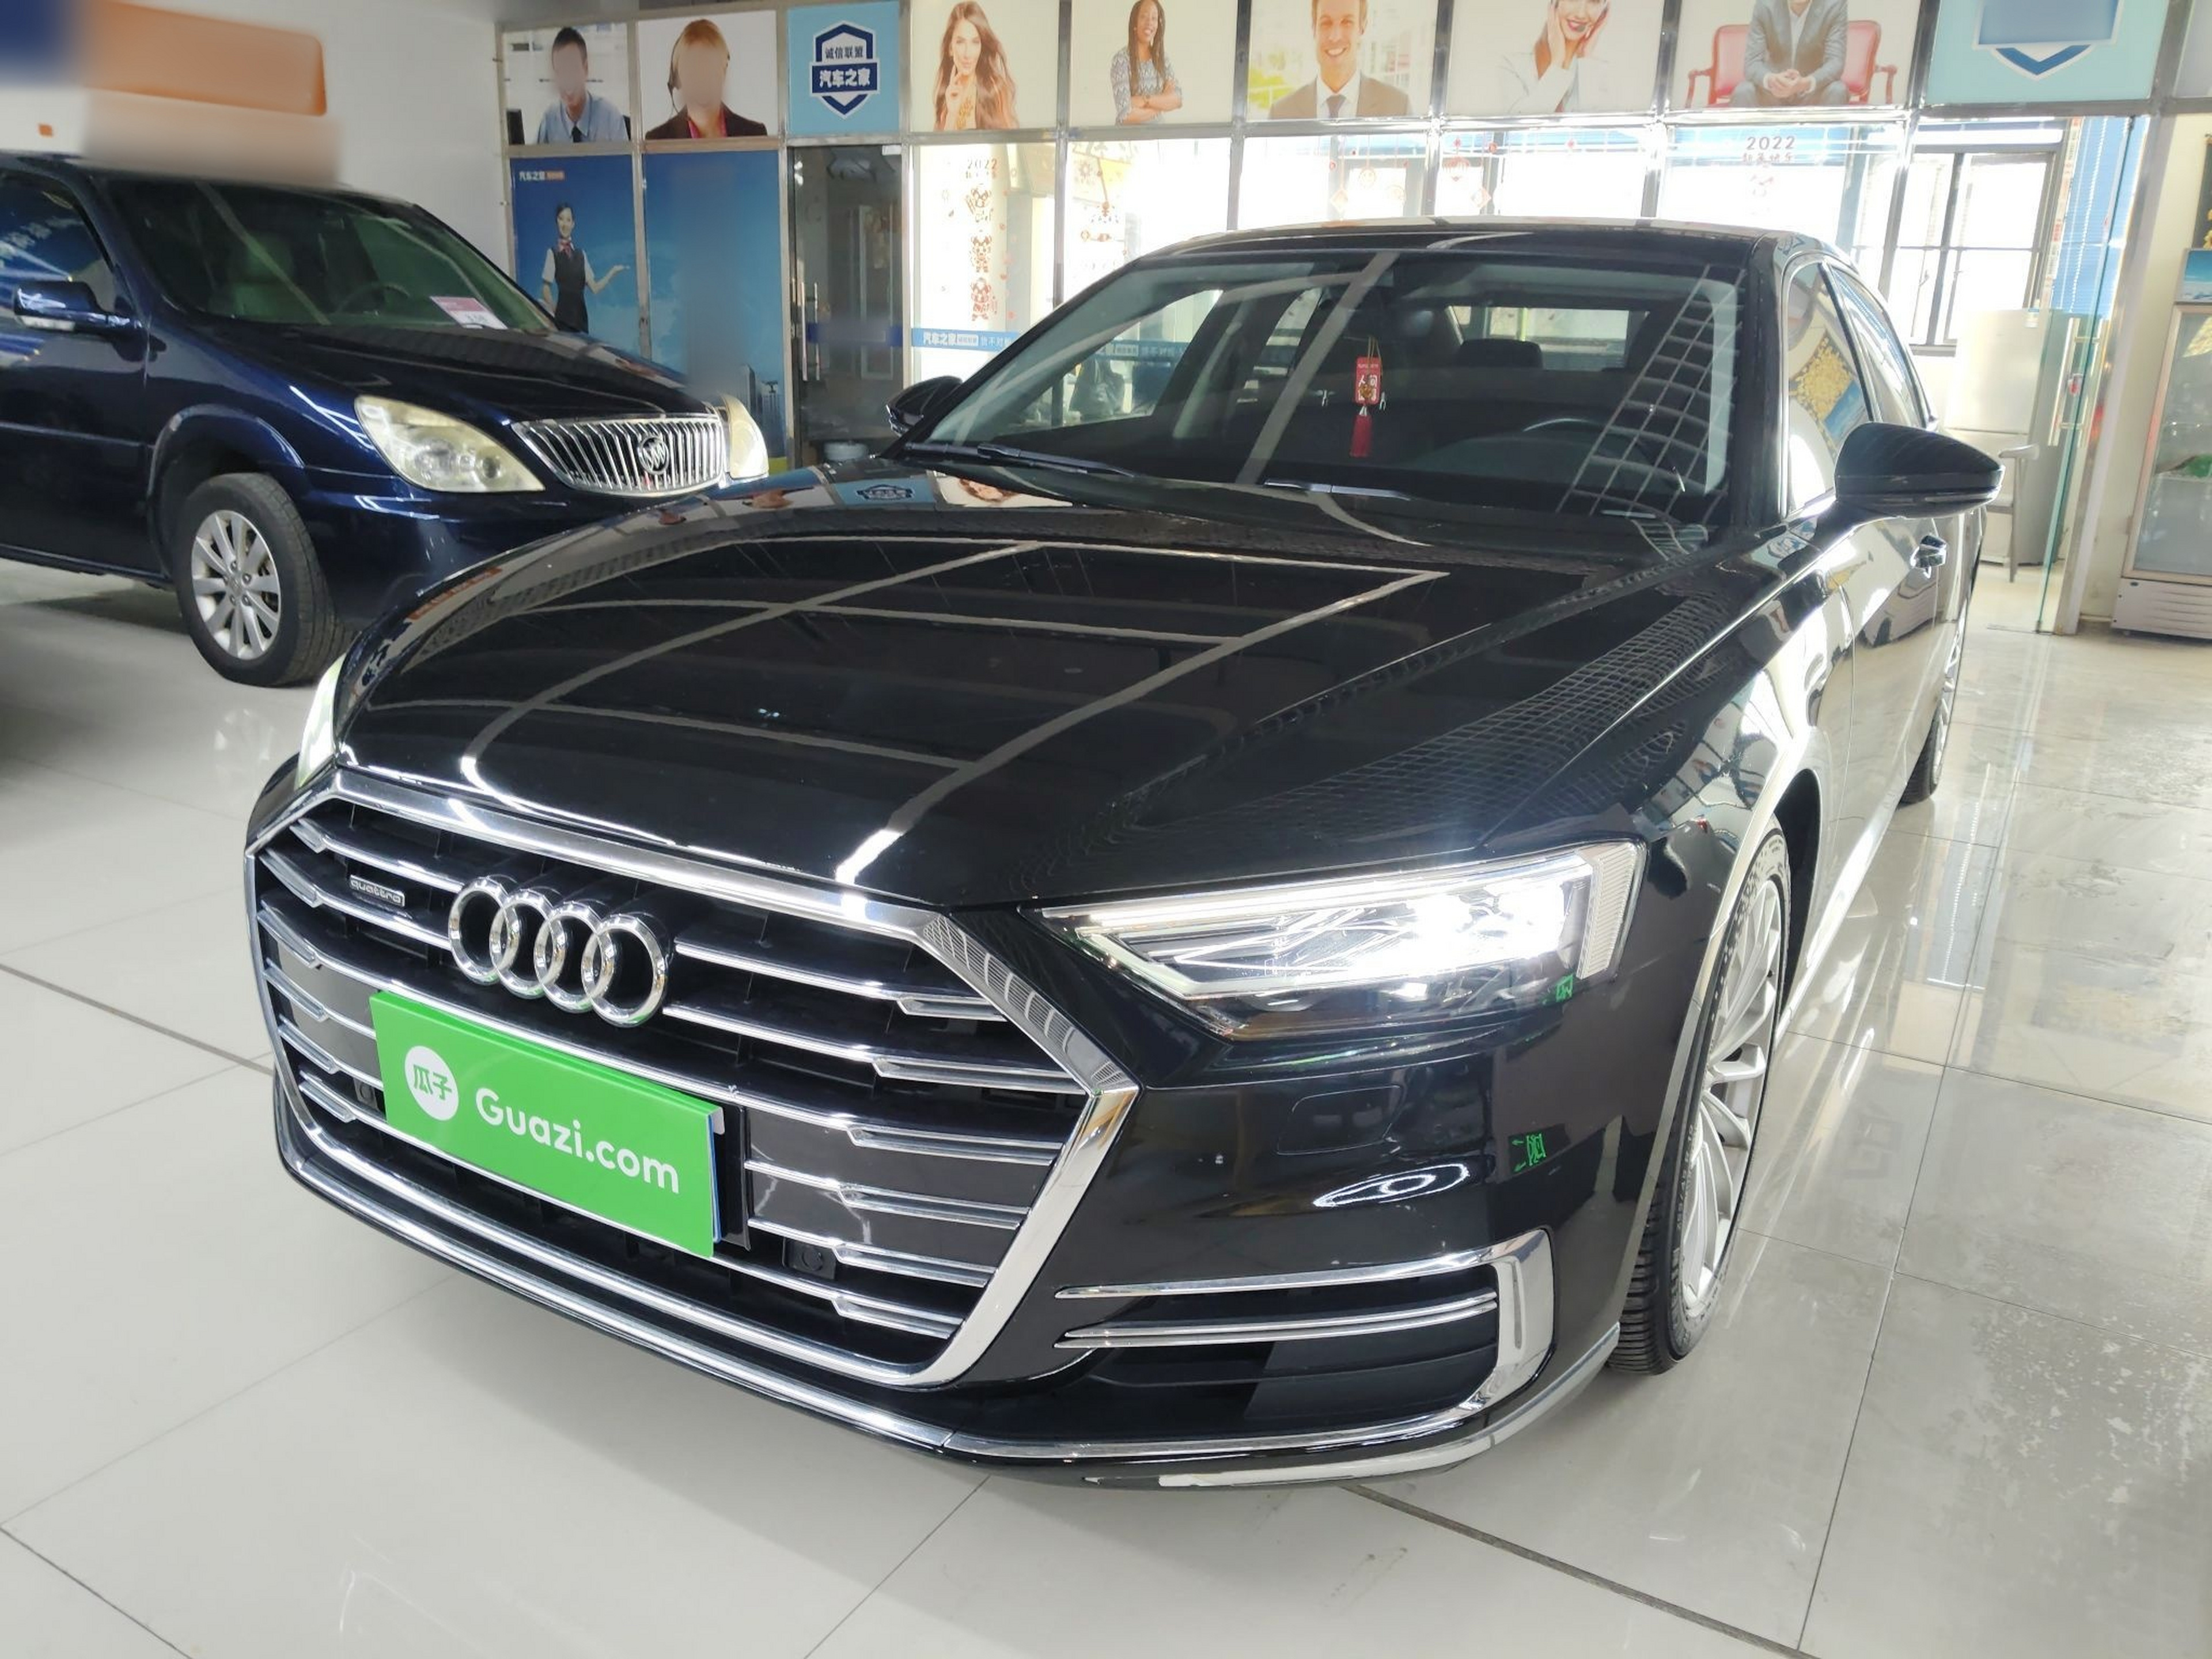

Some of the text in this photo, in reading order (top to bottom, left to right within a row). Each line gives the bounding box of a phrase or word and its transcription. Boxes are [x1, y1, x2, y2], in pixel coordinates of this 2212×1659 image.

[825, 46, 863, 59] 诚信联盟
[819, 67, 870, 88] 汽车之家
[1746, 135, 1796, 150] 2022
[350, 878, 402, 904] quattro
[412, 1063, 452, 1101] 瓜子
[476, 1088, 680, 1194] Guazi.com
